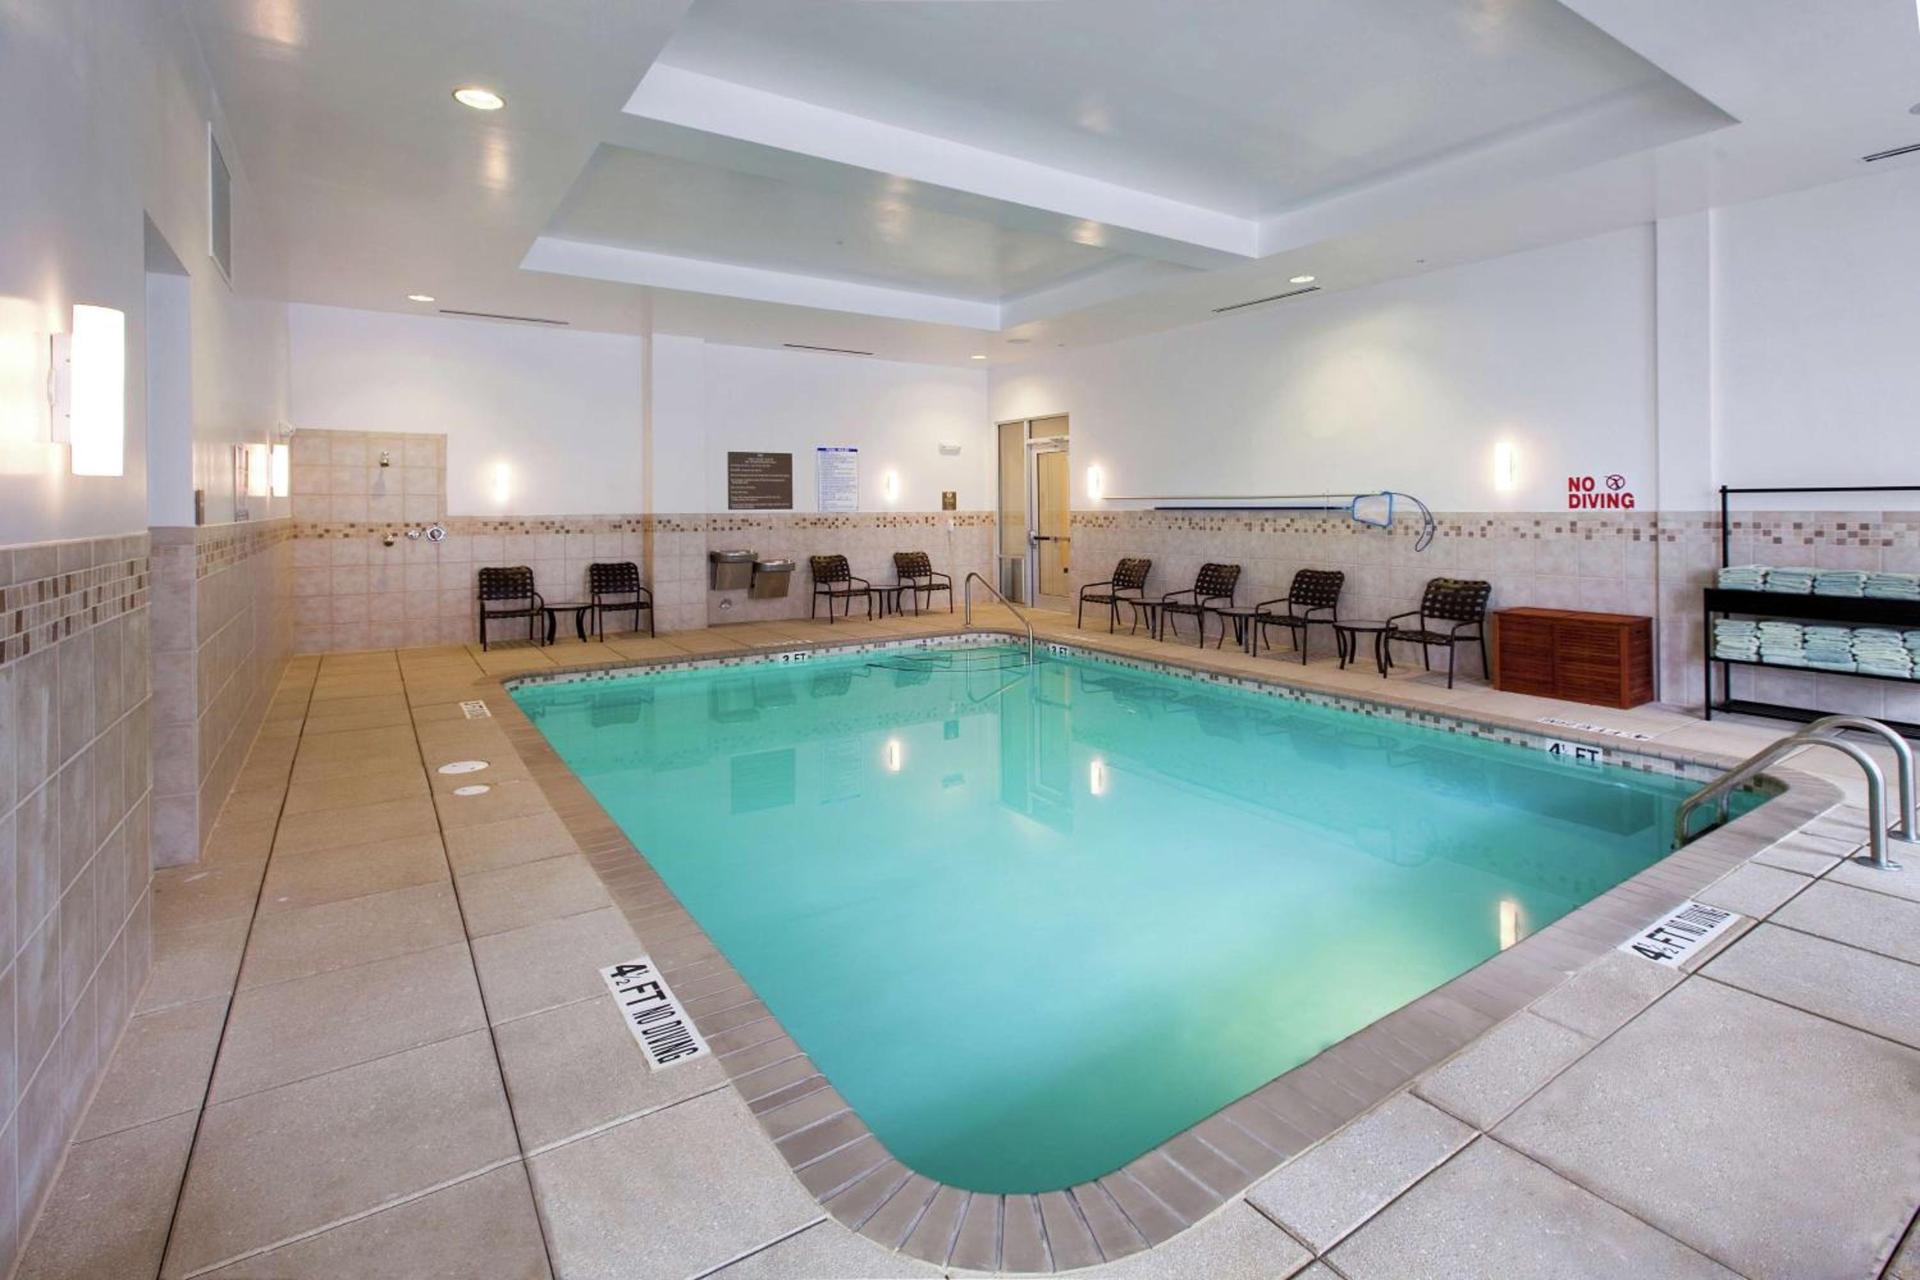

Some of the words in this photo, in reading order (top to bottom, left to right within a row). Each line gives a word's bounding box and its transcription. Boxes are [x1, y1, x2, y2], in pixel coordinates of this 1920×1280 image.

[1568, 476, 1595, 492] NO
[1568, 492, 1635, 509] DIVING
[794, 652, 806, 663] FT
[1575, 746, 1599, 762] FT
[1675, 904, 1731, 929] DIVING
[1663, 919, 1708, 937] NO
[1645, 927, 1697, 950] FT
[619, 980, 667, 1006] FT
[632, 1002, 676, 1025] NO
[641, 1019, 699, 1065] DIVING
